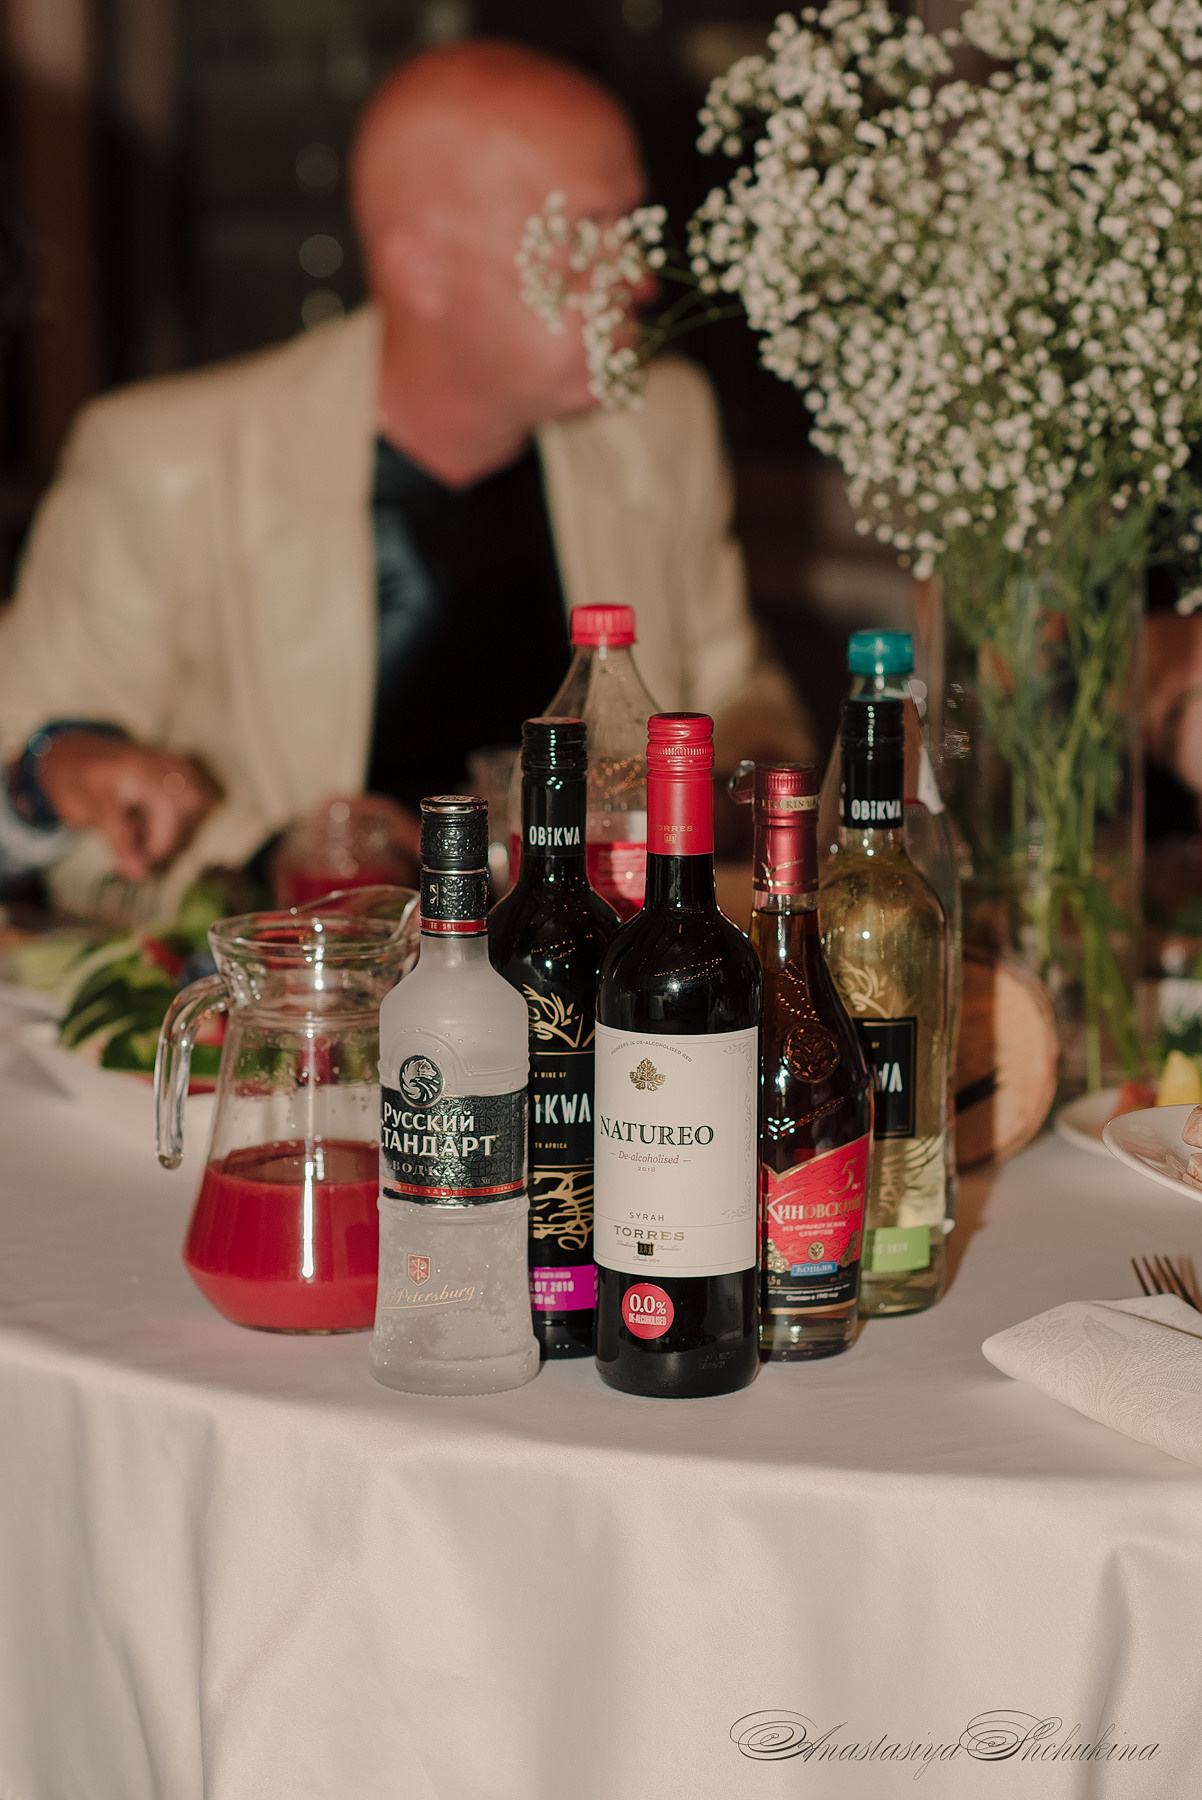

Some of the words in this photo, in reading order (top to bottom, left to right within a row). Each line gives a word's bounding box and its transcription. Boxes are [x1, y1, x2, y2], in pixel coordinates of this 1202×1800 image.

[636, 1040, 682, 1055] DE-ALCOHOLISED
[682, 1053, 693, 1063] RED
[541, 1071, 557, 1079] WINE
[533, 1092, 592, 1125] iKWA
[600, 1115, 714, 1146] NATUREO
[380, 1126, 499, 1158] ТАНДАРТ
[618, 1150, 680, 1165] De-alcoholised
[829, 1158, 858, 1196] 5
[629, 1211, 664, 1222] SYRAH
[614, 1224, 685, 1241] TORRES
[392, 1284, 475, 1305] Petersburg
[629, 1293, 667, 1315] 0.0%
[628, 1312, 667, 1326] DE-ALCOHOLISED
